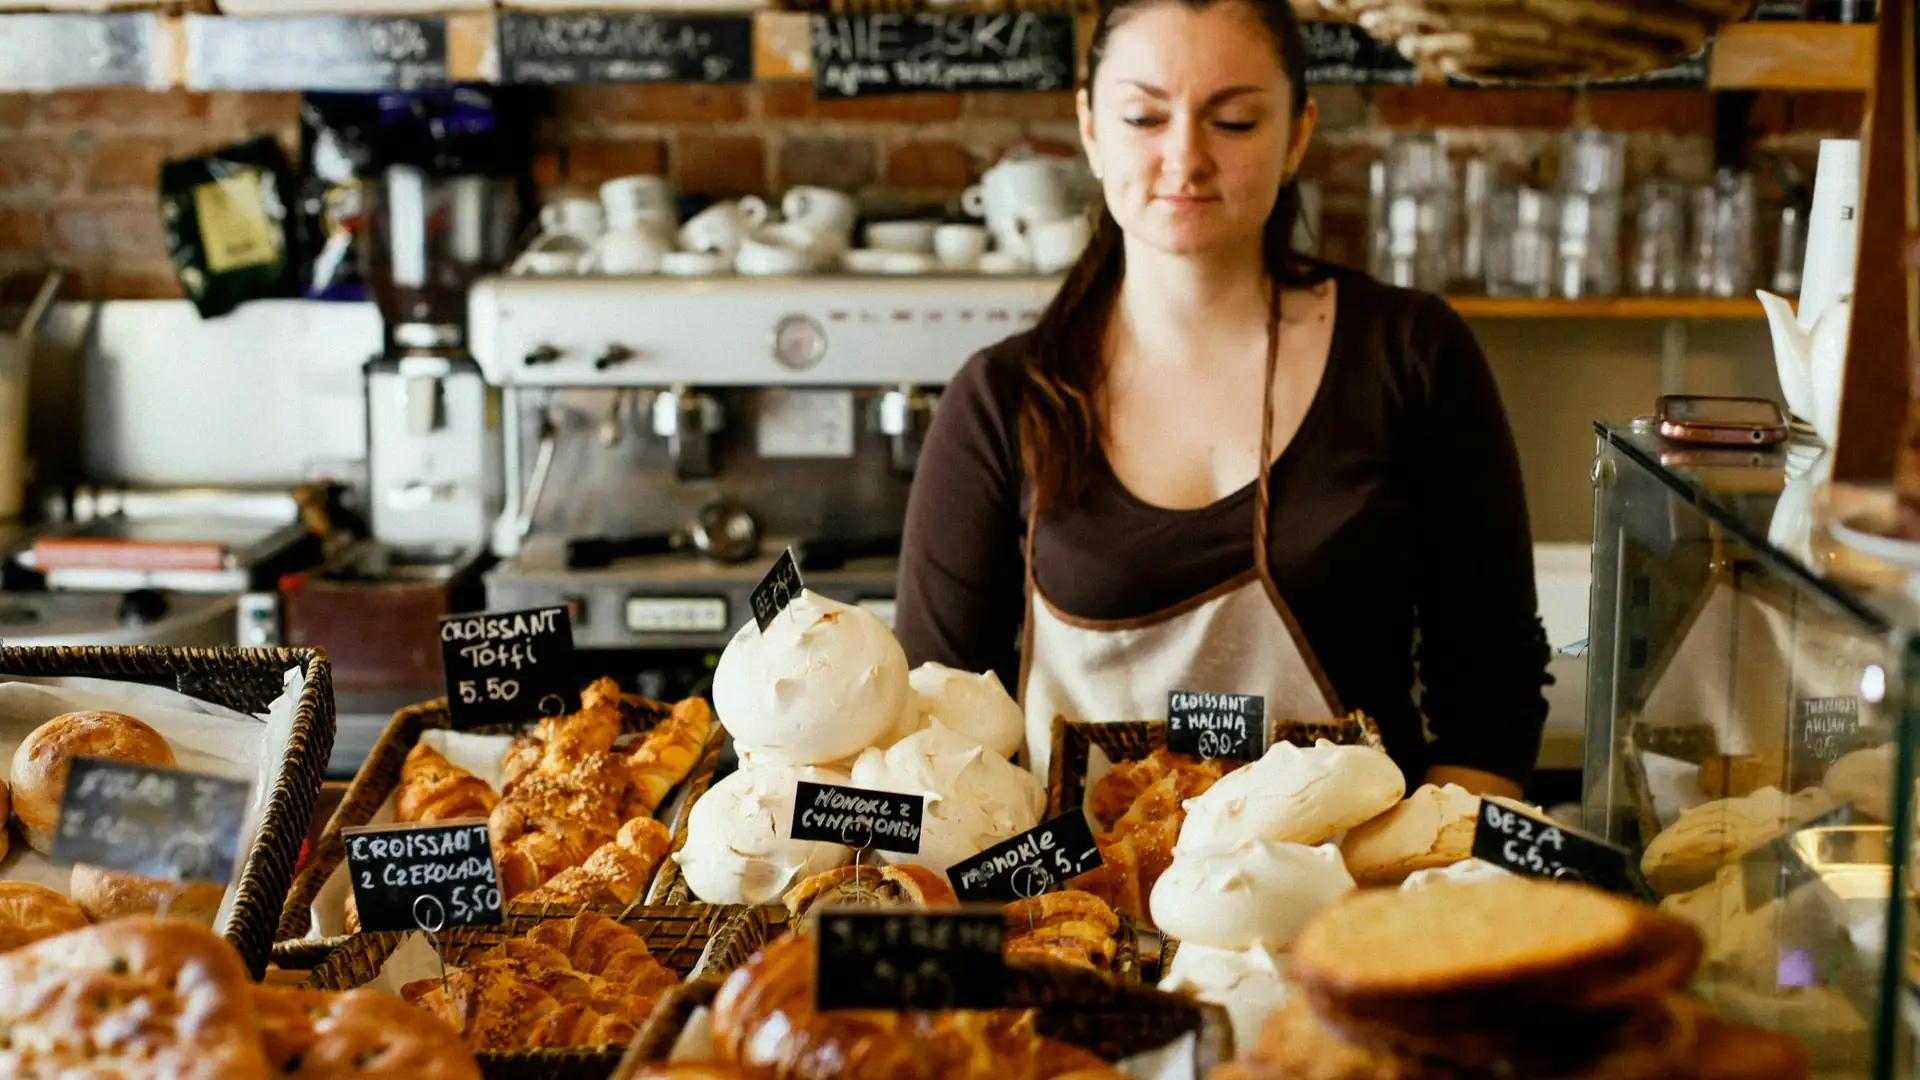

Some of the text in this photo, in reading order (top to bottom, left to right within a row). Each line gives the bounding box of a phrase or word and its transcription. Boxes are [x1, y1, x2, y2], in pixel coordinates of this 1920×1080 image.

[441, 608, 562, 641] CROISSANT
[459, 677, 519, 704] 5.50
[1171, 693, 1251, 713] CROISSANT
